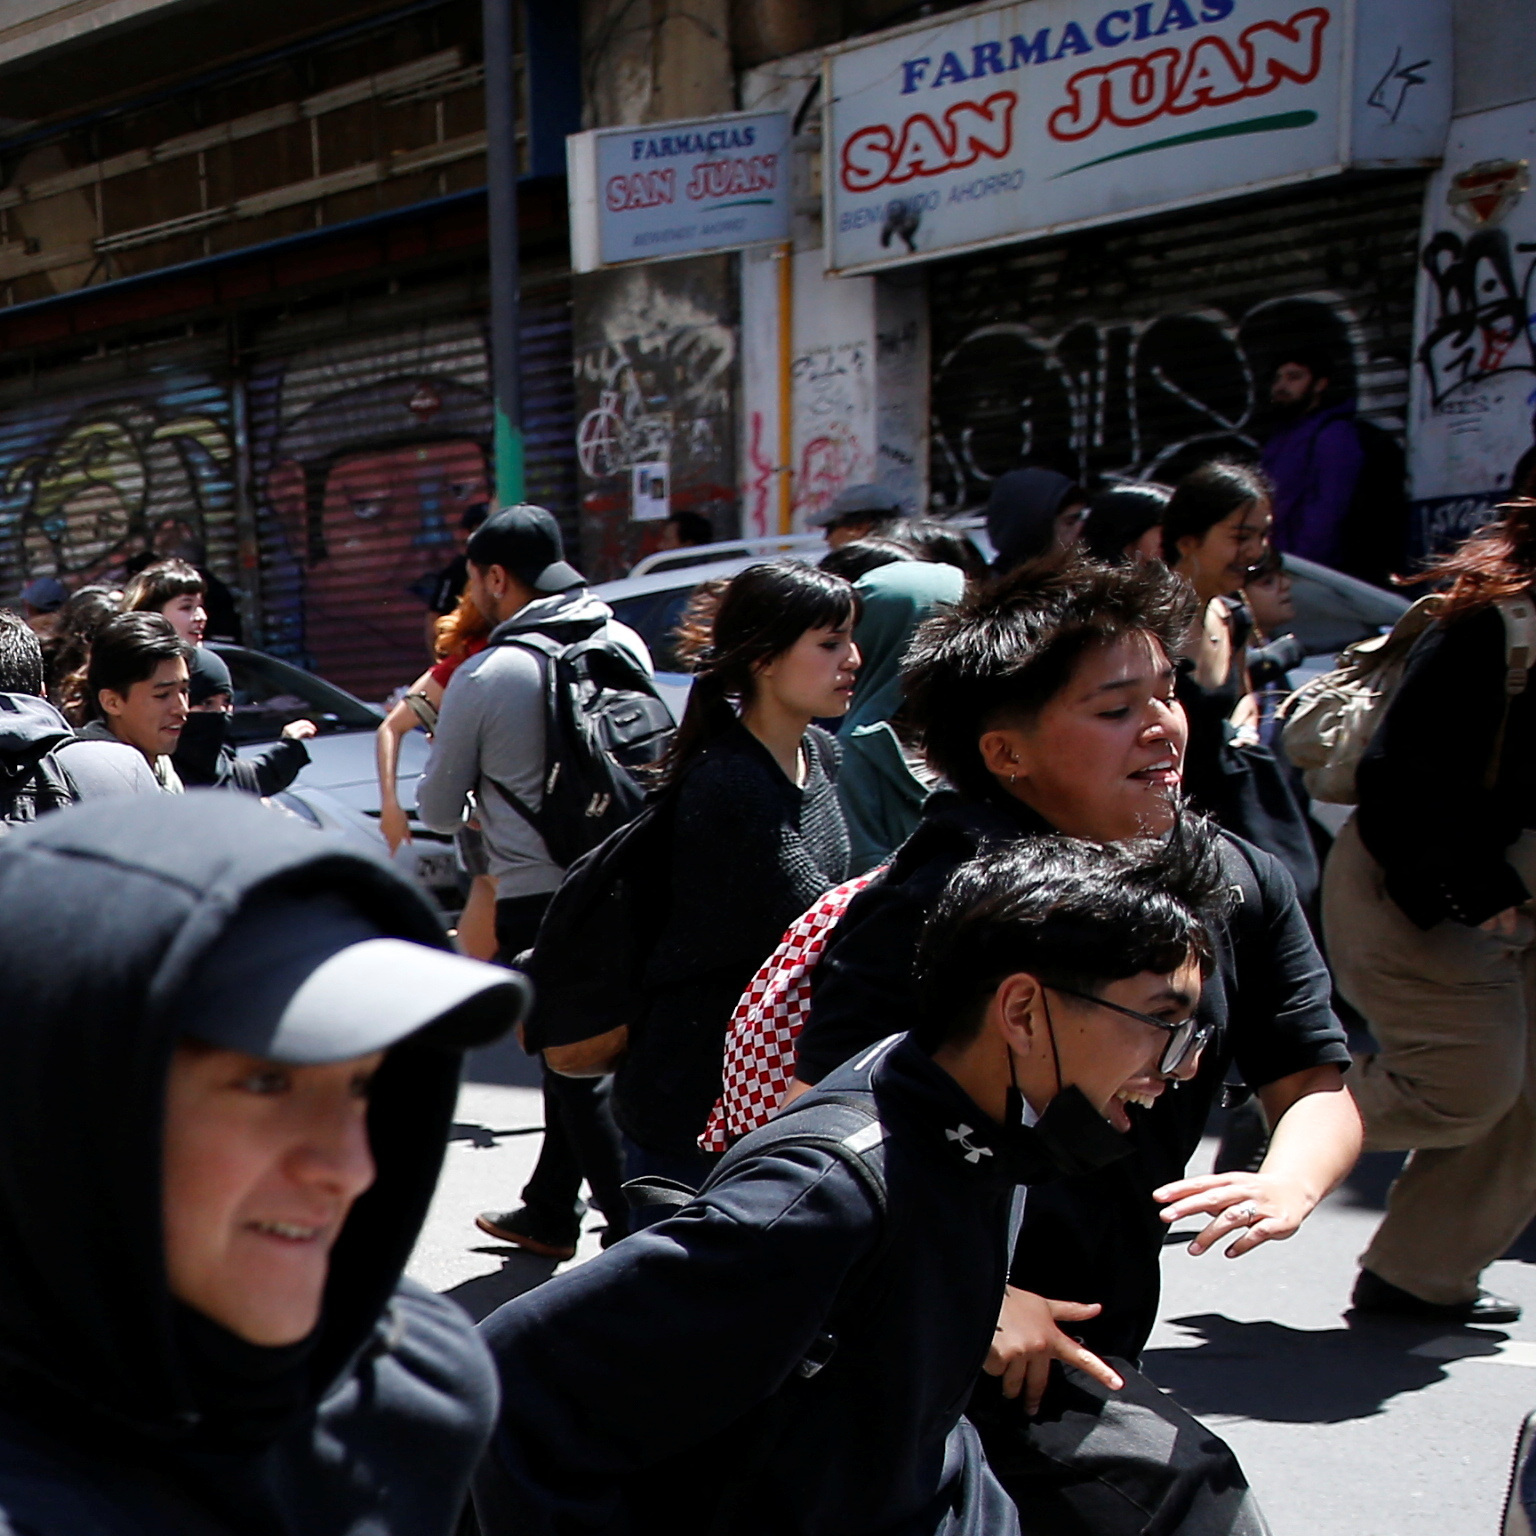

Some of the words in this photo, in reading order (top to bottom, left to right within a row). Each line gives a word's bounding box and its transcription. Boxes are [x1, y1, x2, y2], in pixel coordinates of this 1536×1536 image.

[900, 0, 1235, 95] FARMACIAS
[841, 91, 1018, 193] SAN
[1048, 7, 1330, 141] JUAN
[631, 126, 756, 161] FARMACIAS
[606, 167, 676, 212] SAN
[686, 153, 777, 200] JUAN
